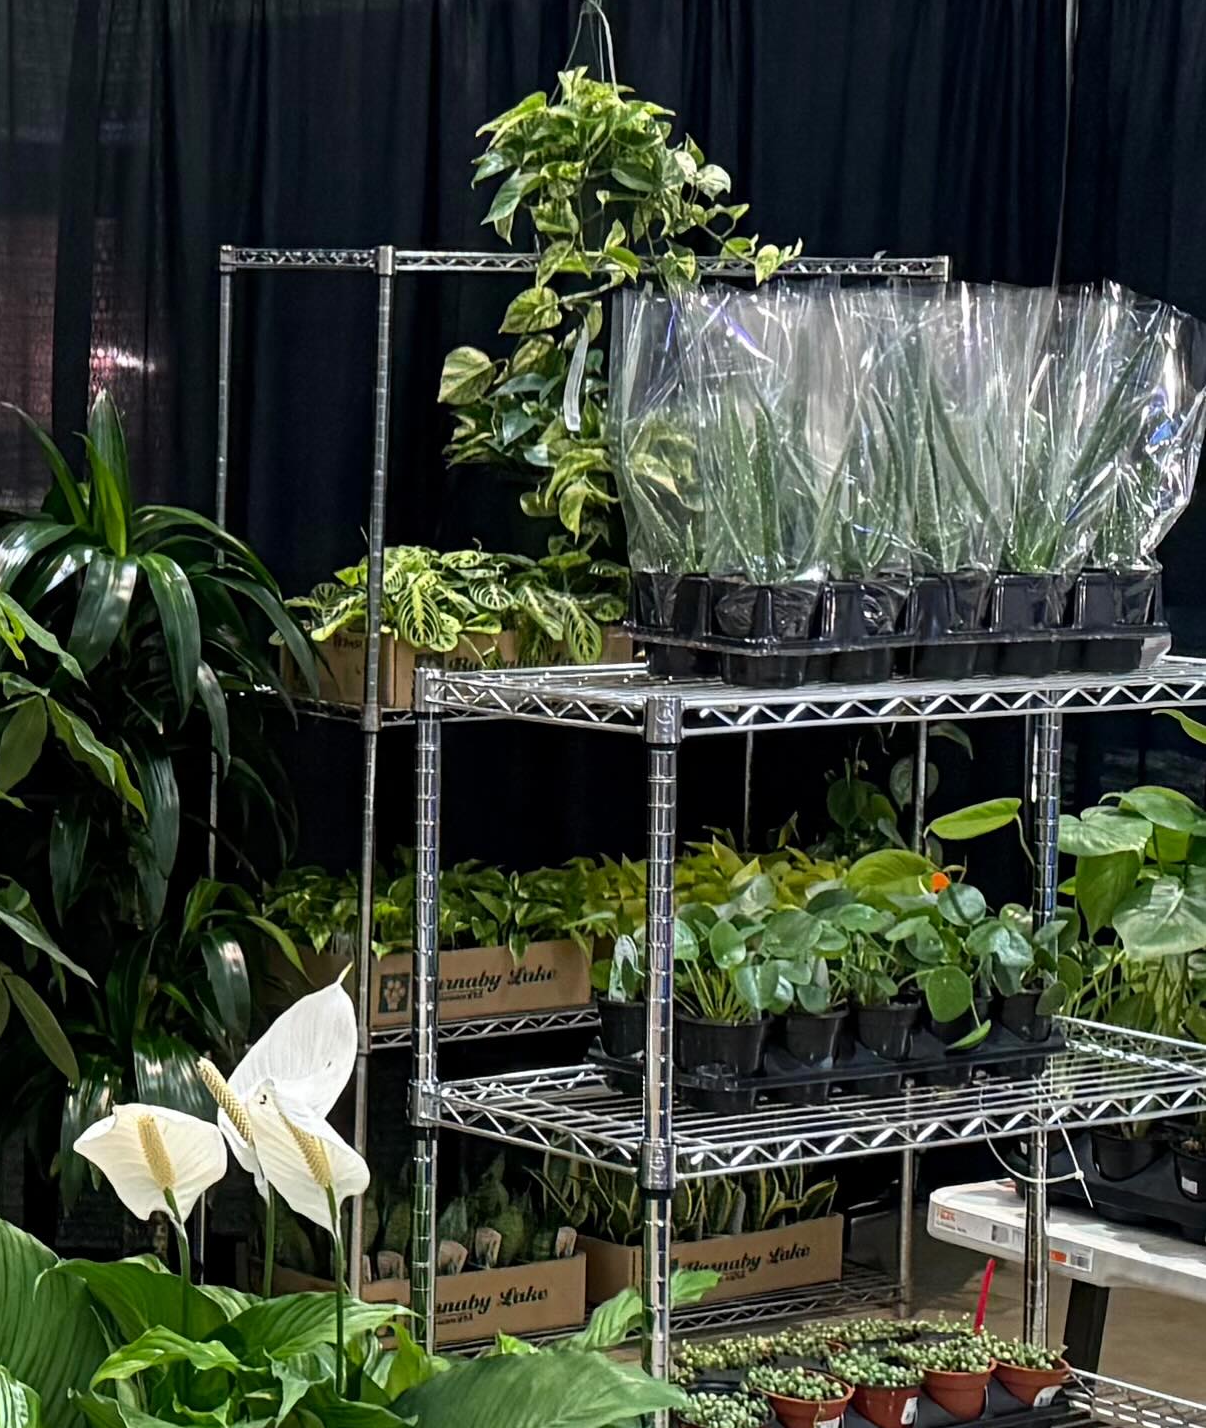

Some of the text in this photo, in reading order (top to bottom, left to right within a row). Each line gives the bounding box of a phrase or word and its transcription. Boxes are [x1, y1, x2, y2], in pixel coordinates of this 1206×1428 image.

[438, 964, 556, 993] rnaby Lake
[768, 1243, 811, 1264] Lake
[498, 1285, 548, 1307] Lake
